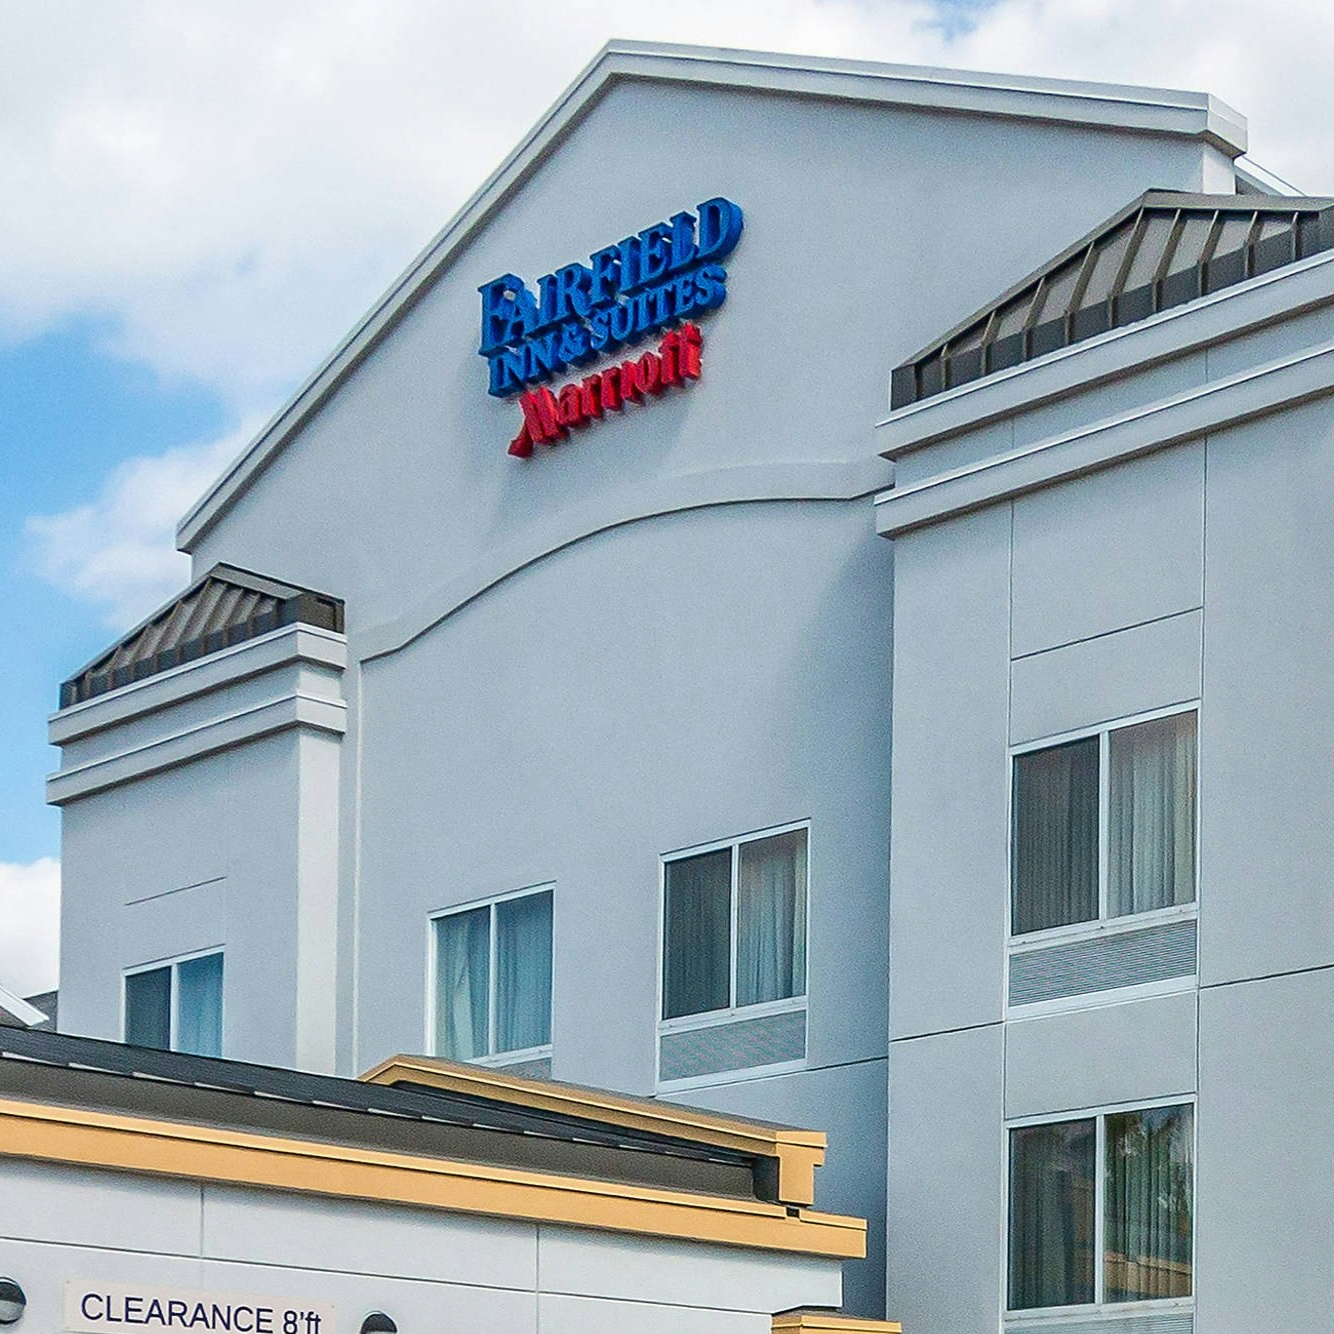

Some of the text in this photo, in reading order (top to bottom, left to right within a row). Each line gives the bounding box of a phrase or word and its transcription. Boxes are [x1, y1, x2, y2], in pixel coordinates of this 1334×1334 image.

[478, 197, 743, 356] FAIRFIELD
[507, 320, 702, 458] Marriott
[80, 1293, 273, 1334] CLEARANCE
